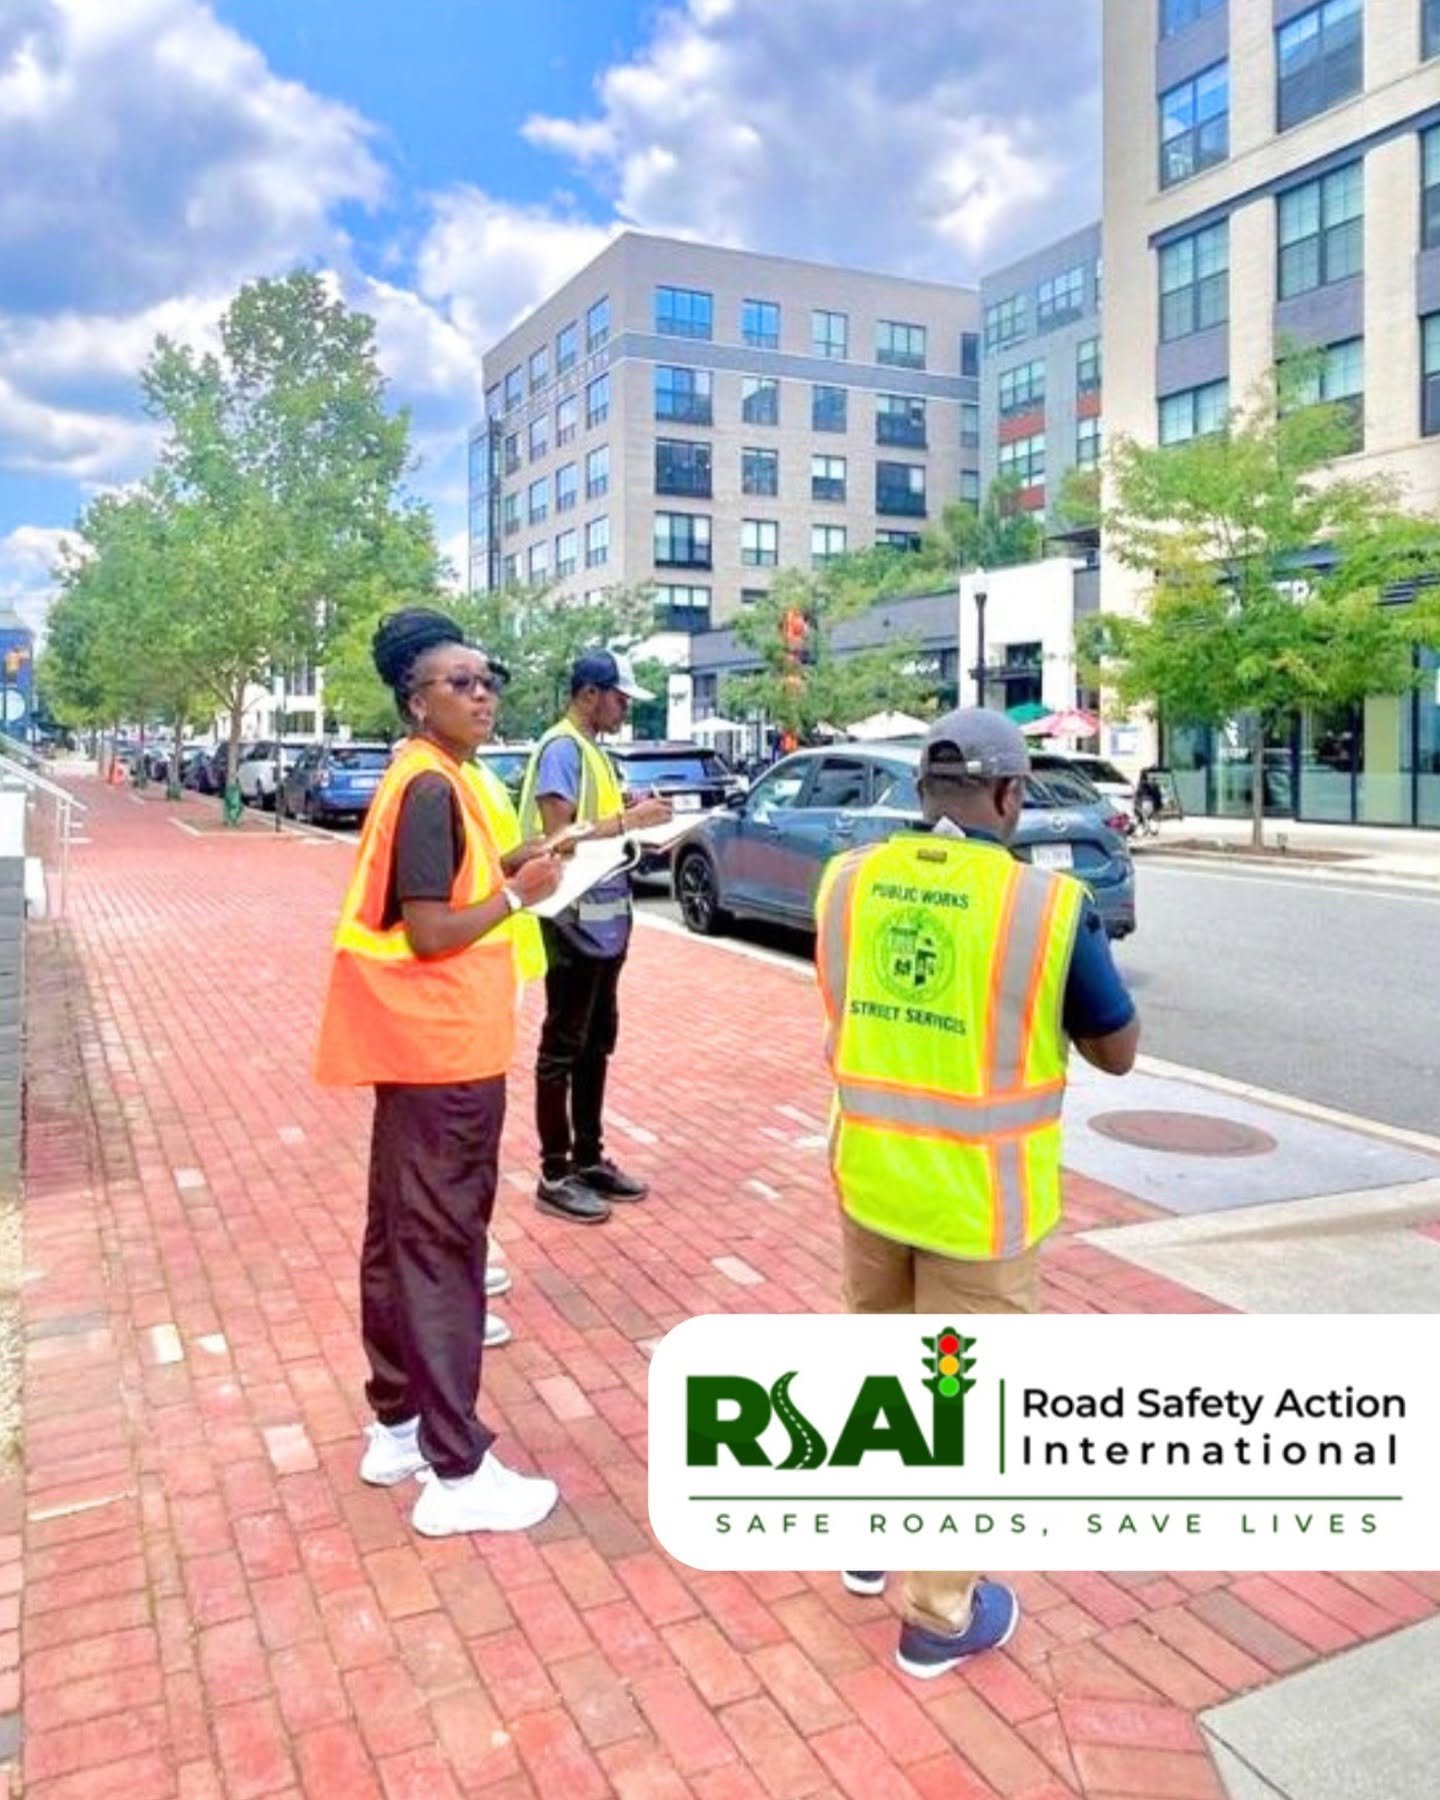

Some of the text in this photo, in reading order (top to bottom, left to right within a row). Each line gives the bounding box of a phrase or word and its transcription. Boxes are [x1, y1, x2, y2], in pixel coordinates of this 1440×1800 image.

[873, 884, 968, 909] PUBLIC WORKS
[851, 1001, 966, 1035] STREET SERVICES
